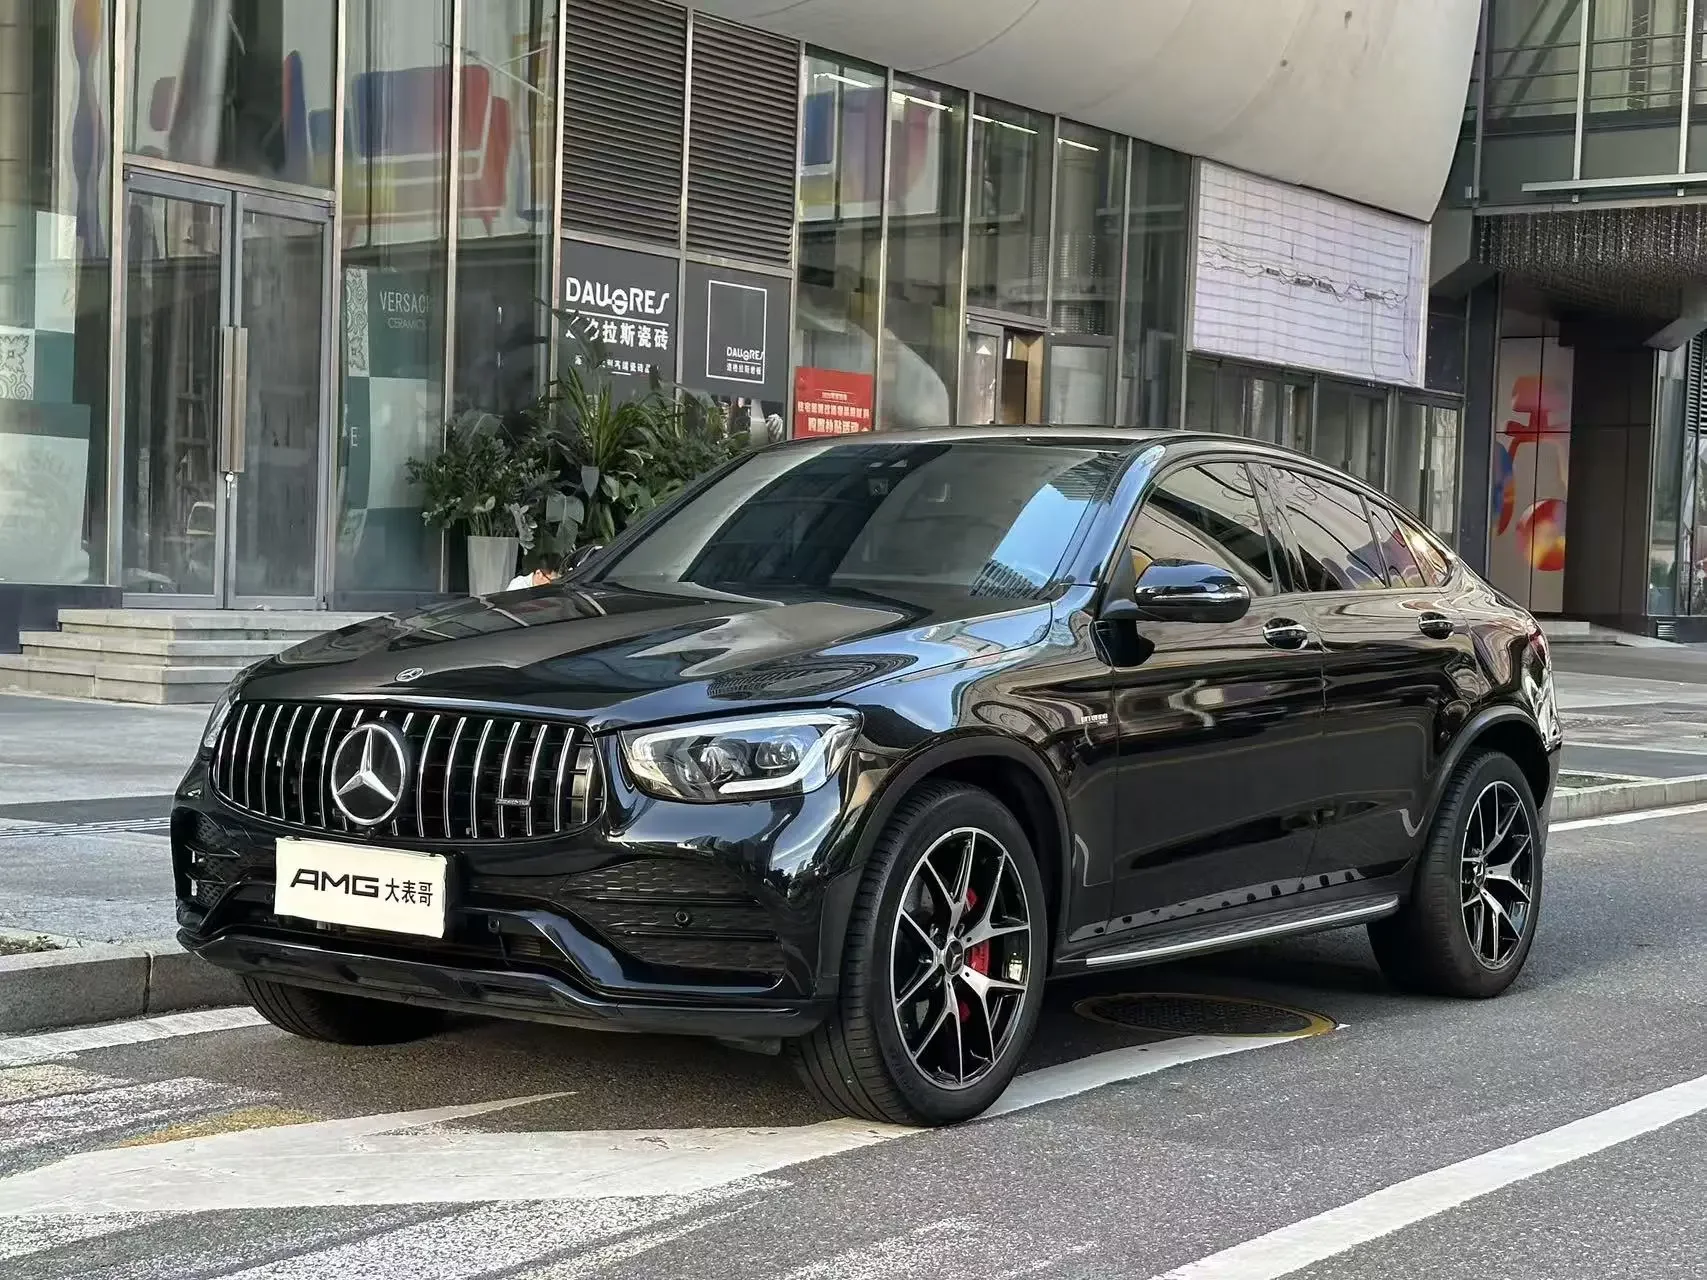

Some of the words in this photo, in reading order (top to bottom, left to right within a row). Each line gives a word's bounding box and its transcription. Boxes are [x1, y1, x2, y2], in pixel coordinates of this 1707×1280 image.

[565, 316, 669, 350] 拉斯瓷砖
[290, 868, 379, 898] AMG
[385, 877, 433, 907] 大表哥
